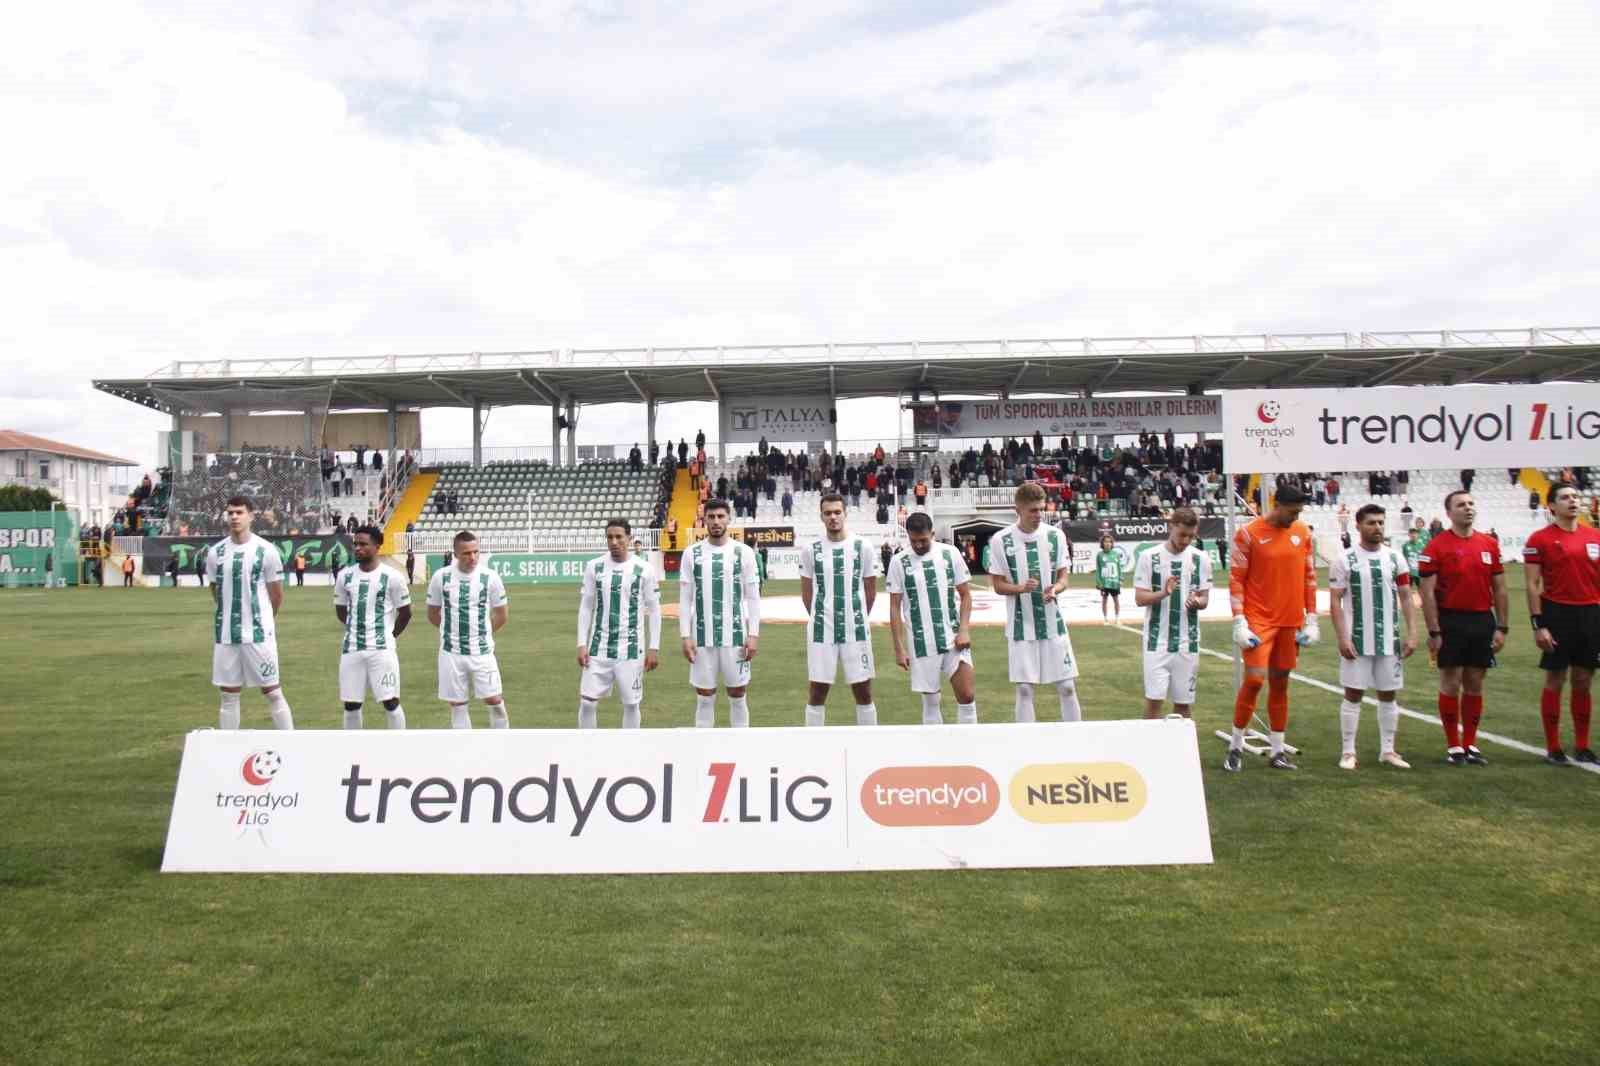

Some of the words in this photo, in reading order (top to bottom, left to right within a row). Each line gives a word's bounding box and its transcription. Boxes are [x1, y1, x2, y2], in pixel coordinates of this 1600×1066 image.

[760, 408, 825, 422] TALYA
[975, 403, 1000, 420] TÜM
[1004, 402, 1087, 419] SPORCULARA
[1092, 401, 1161, 418] BAŞARILAR
[1167, 399, 1217, 416] DİLERİM
[1244, 426, 1295, 438] trendyol
[1319, 404, 1512, 450] trendyol
[1115, 522, 1168, 536] trendyol
[519, 560, 558, 577] SERİK
[381, 671, 397, 687] 40
[215, 792, 299, 810] trendyol
[341, 763, 673, 836] trendyol
[873, 783, 988, 809] trendyol
